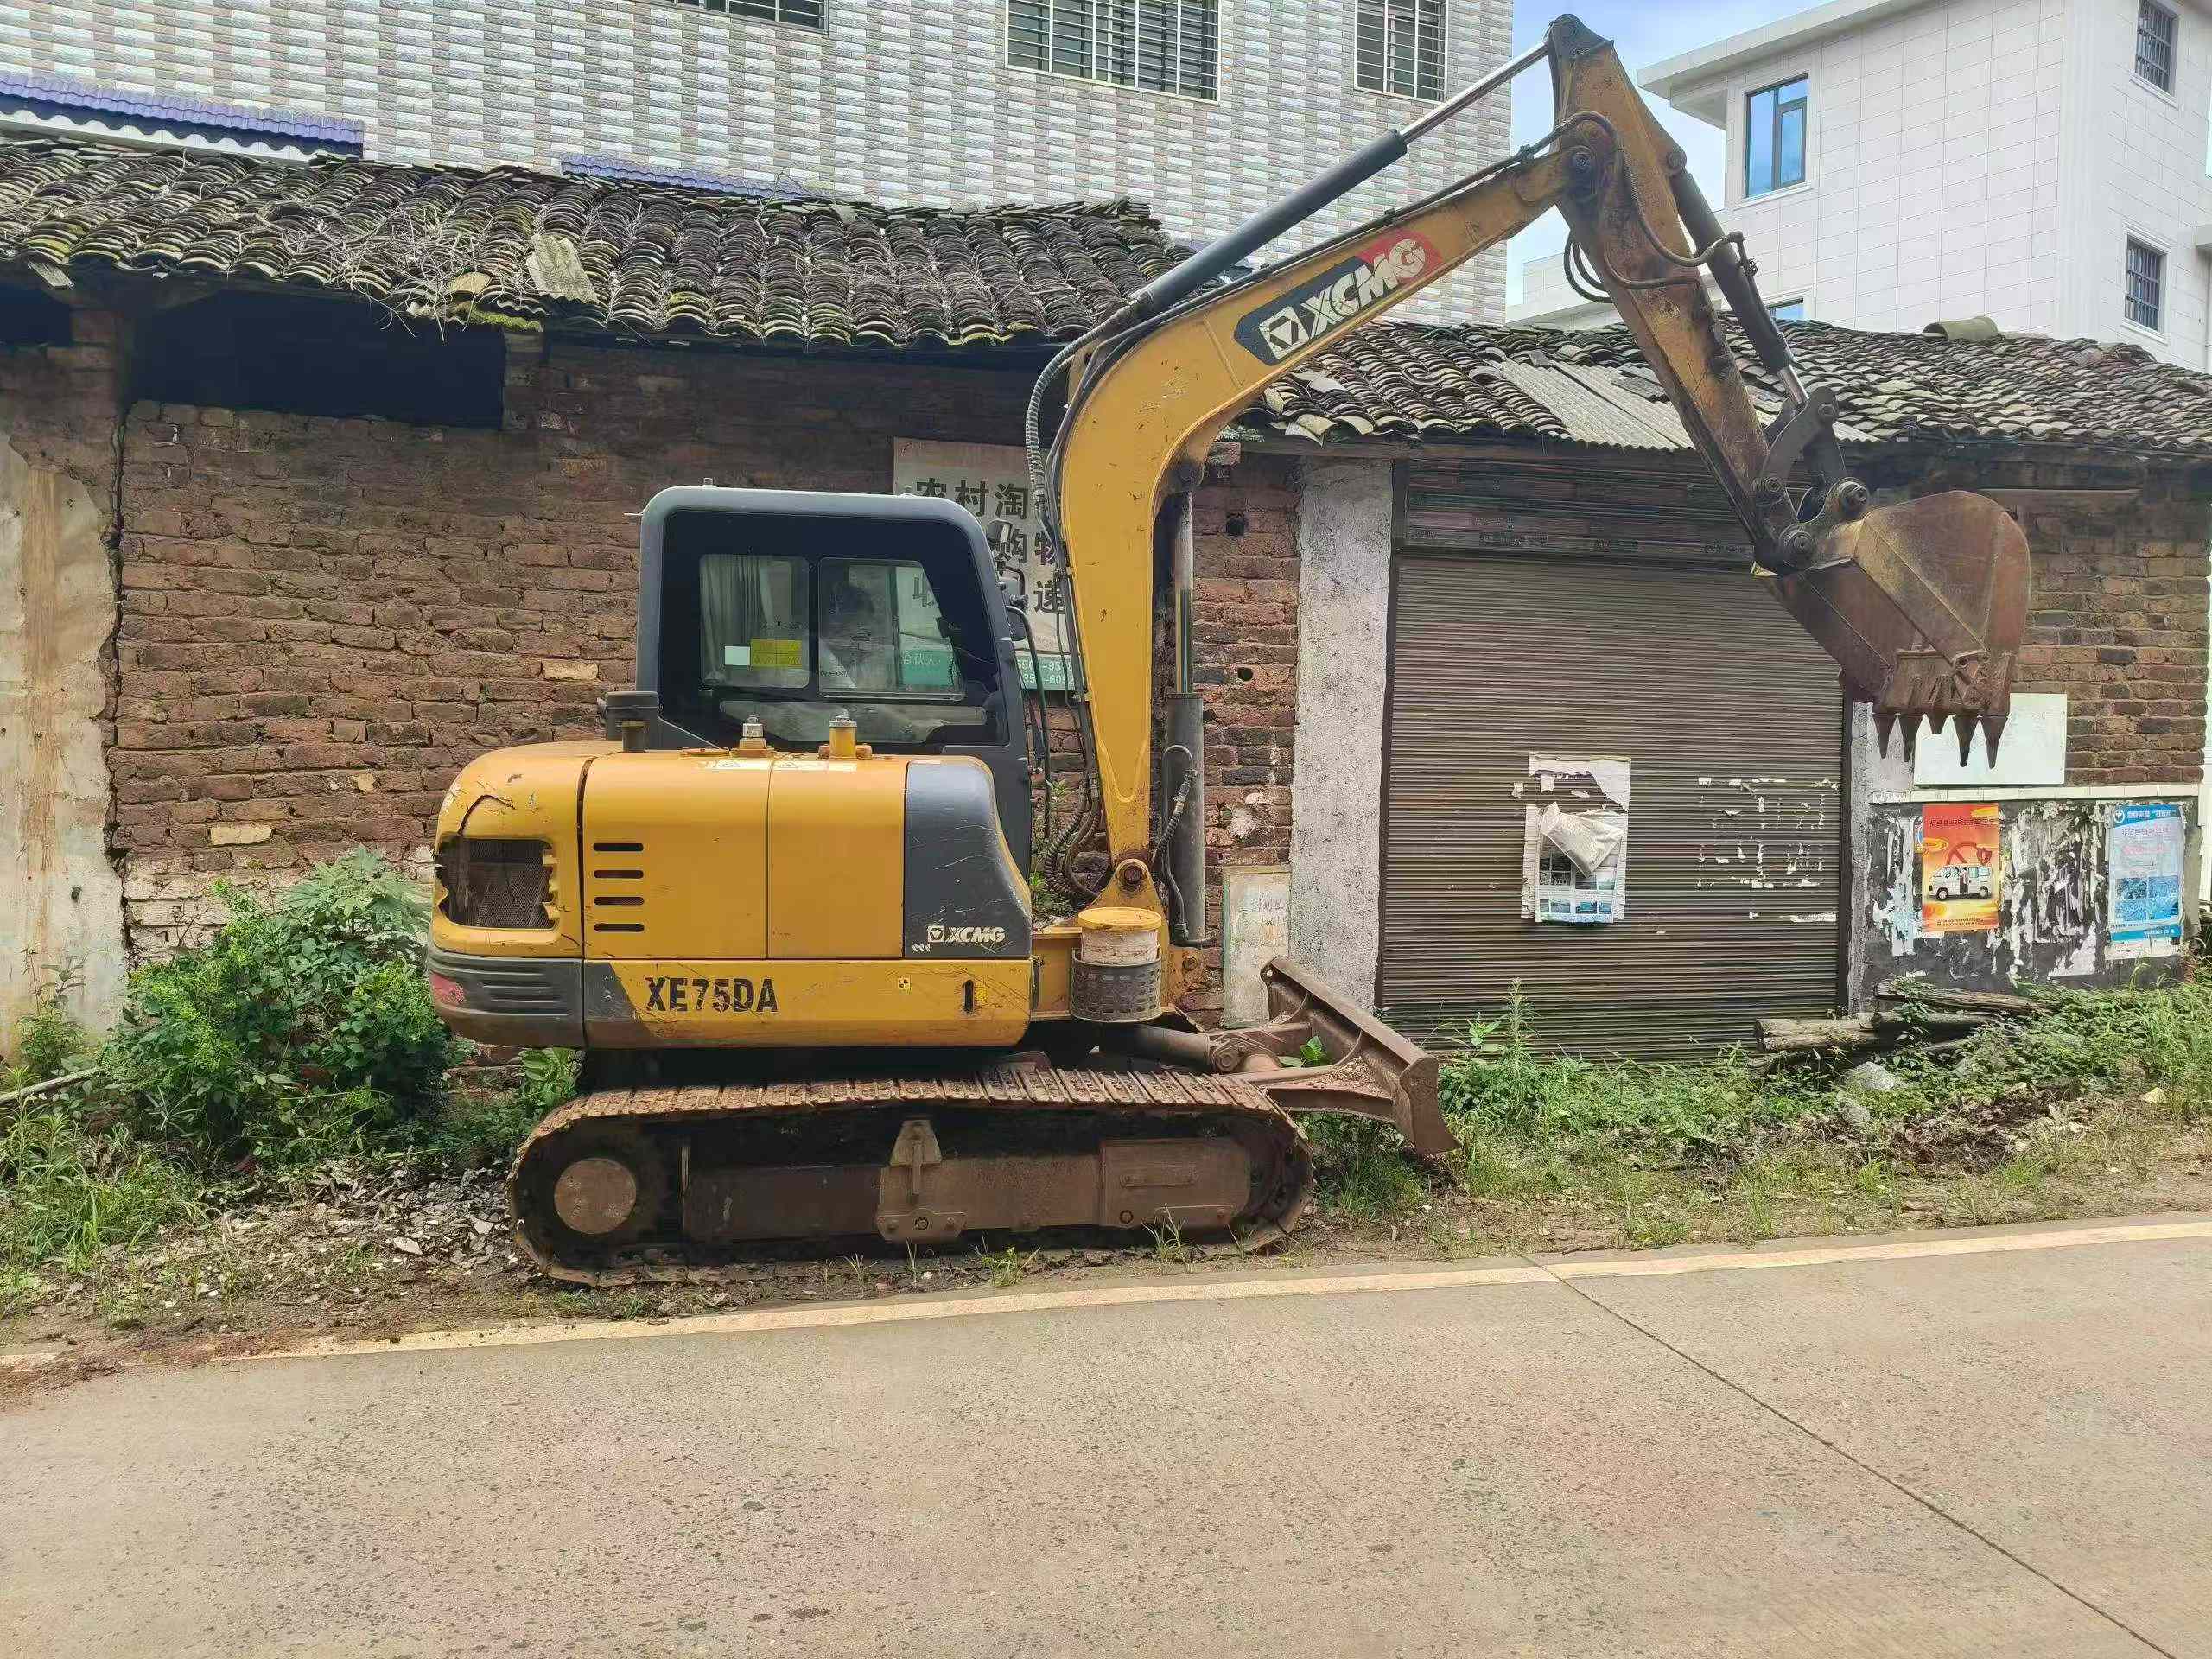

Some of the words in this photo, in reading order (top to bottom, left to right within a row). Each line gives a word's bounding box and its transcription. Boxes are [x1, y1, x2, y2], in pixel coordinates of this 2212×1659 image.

[1300, 239, 1426, 339] XCMG
[945, 926, 1006, 942] XCMG
[645, 977, 778, 1013] XE75DA
